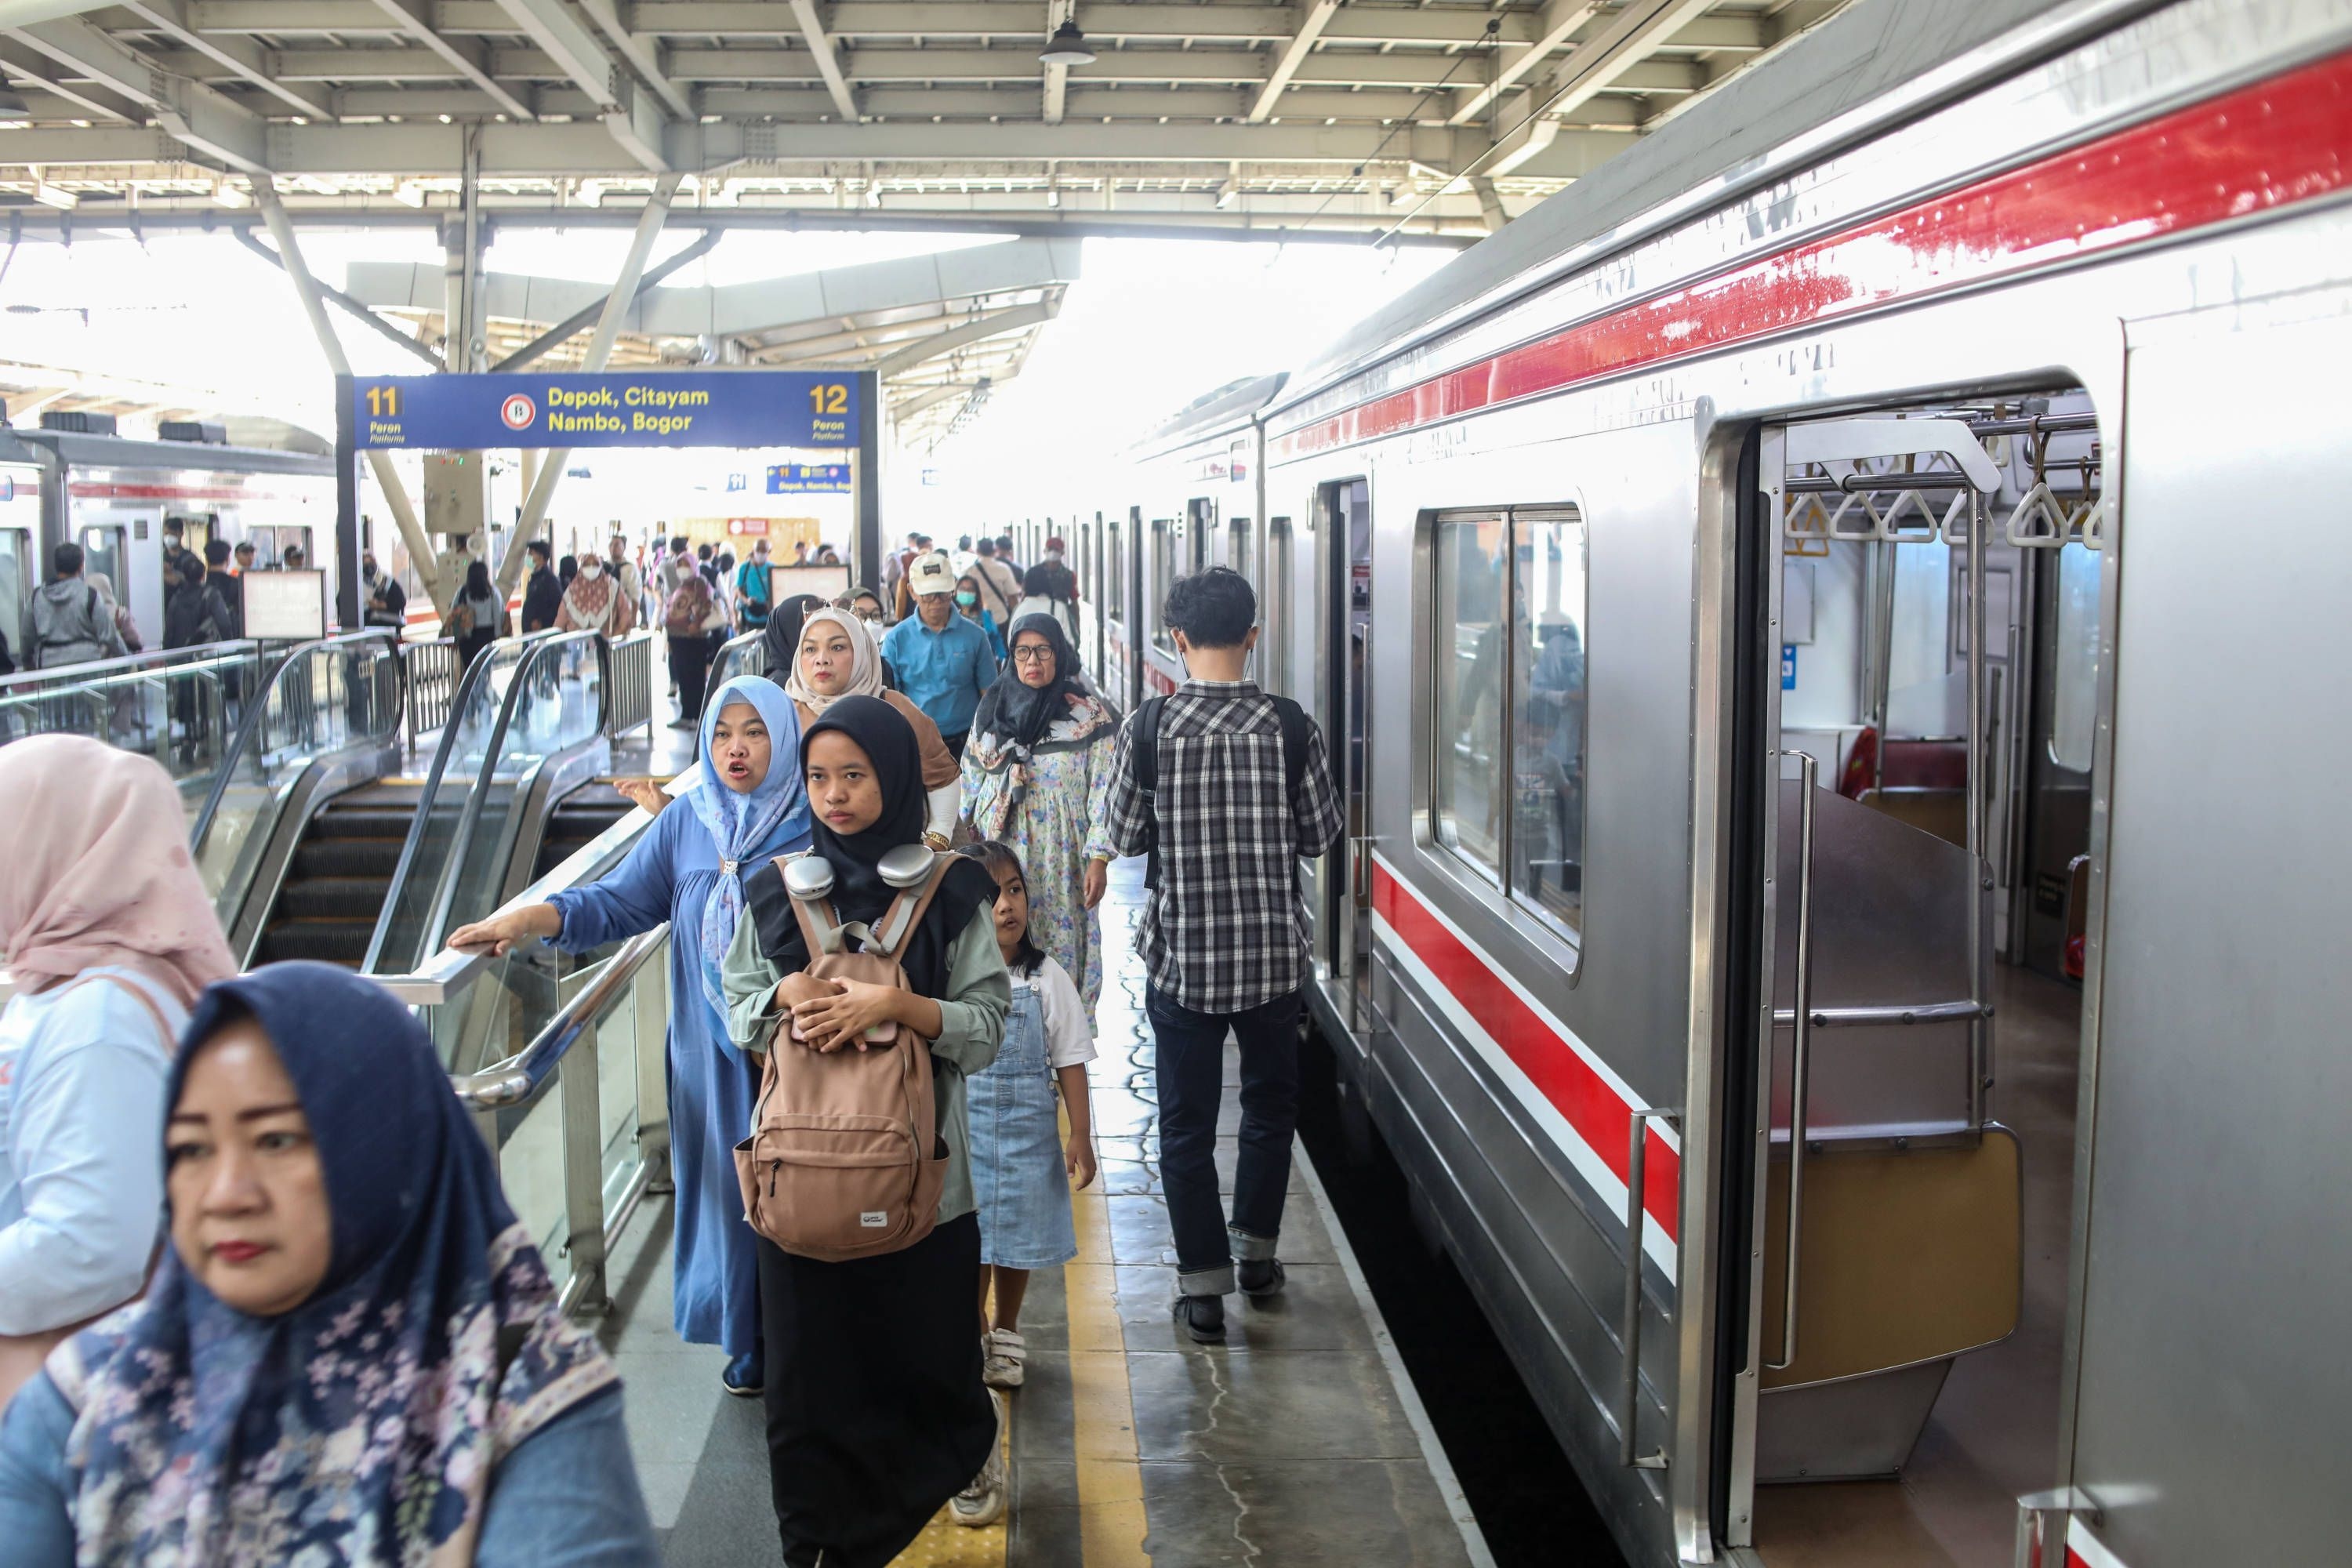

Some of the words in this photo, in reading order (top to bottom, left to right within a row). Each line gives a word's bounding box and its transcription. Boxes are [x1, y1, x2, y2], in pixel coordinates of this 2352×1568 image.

[366, 386, 396, 416] 11
[548, 386, 619, 410] Depok,
[624, 386, 710, 410] Citayam
[809, 384, 848, 414] 12
[370, 421, 401, 434] Peron
[549, 412, 627, 435] Nambo,
[633, 412, 693, 435] Bogor
[812, 419, 845, 431] Peron
[369, 434, 405, 445] Platforms
[811, 432, 845, 441] Platform
